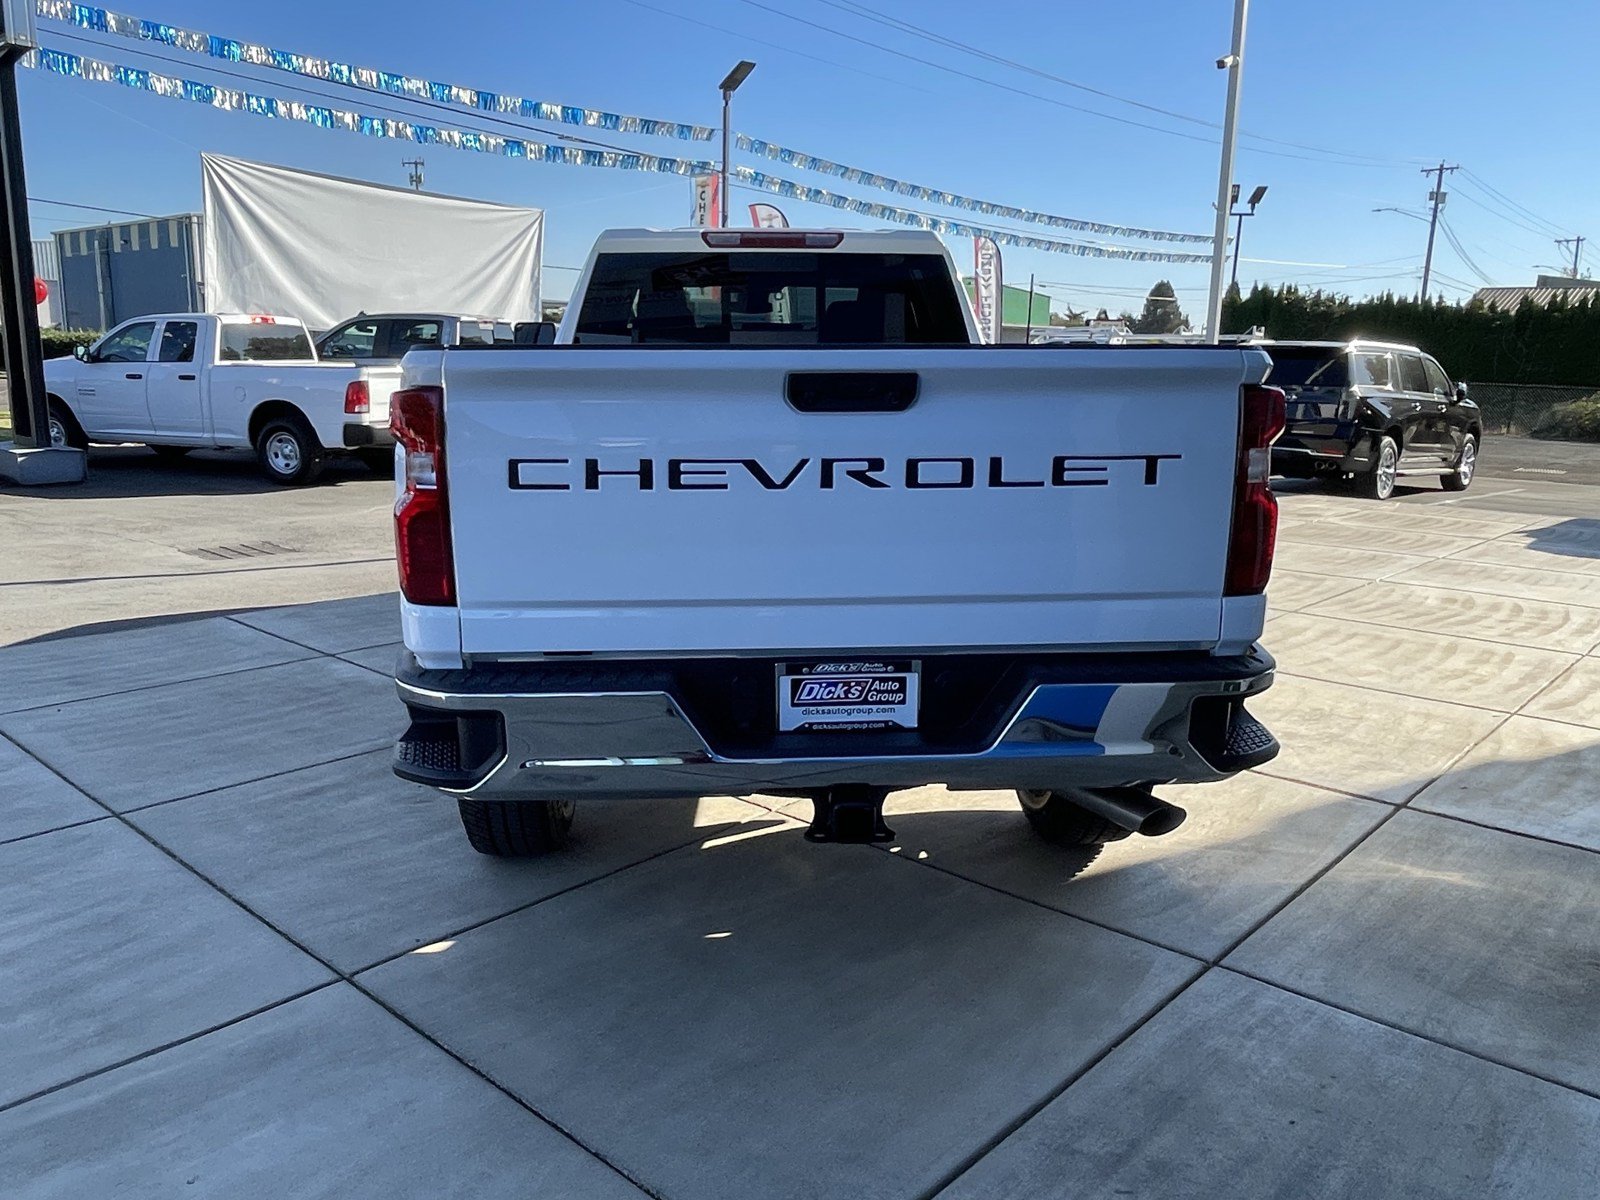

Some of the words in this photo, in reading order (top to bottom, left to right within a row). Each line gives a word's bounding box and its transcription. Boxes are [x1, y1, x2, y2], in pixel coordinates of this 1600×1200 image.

[508, 454, 1182, 490] CHEVROLET
[800, 683, 862, 700] Dick's
[871, 681, 899, 690] Auto
[867, 692, 904, 703] Group
[802, 706, 896, 716] dicksautogroup.com
